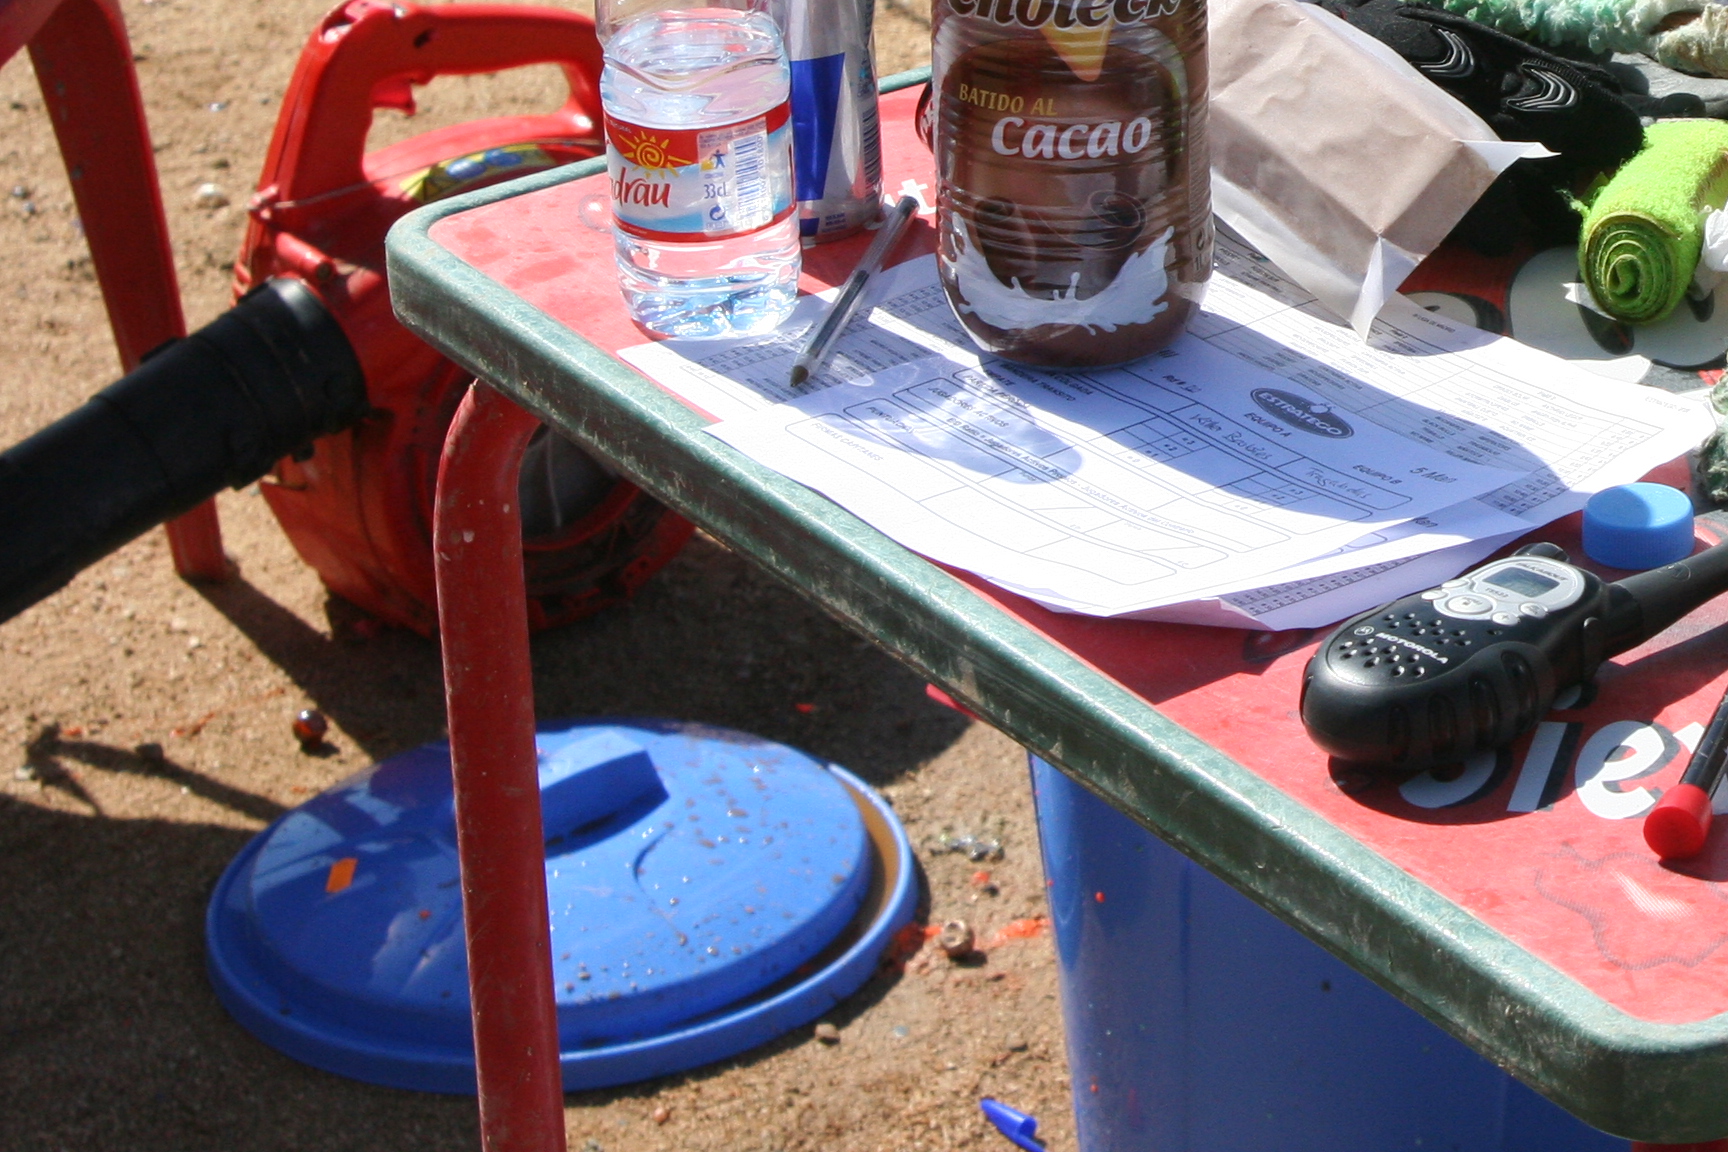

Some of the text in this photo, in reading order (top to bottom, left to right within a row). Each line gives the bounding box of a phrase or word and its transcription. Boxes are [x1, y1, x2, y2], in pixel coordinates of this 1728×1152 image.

[959, 83, 1057, 116] BATIDO AL
[991, 116, 1152, 159] Cacao
[703, 182, 727, 199] 33cl
[1244, 412, 1283, 434] EQUIPO
[1258, 391, 1344, 436] ESTRATEGO
[1374, 631, 1449, 665] MOTOROLA
